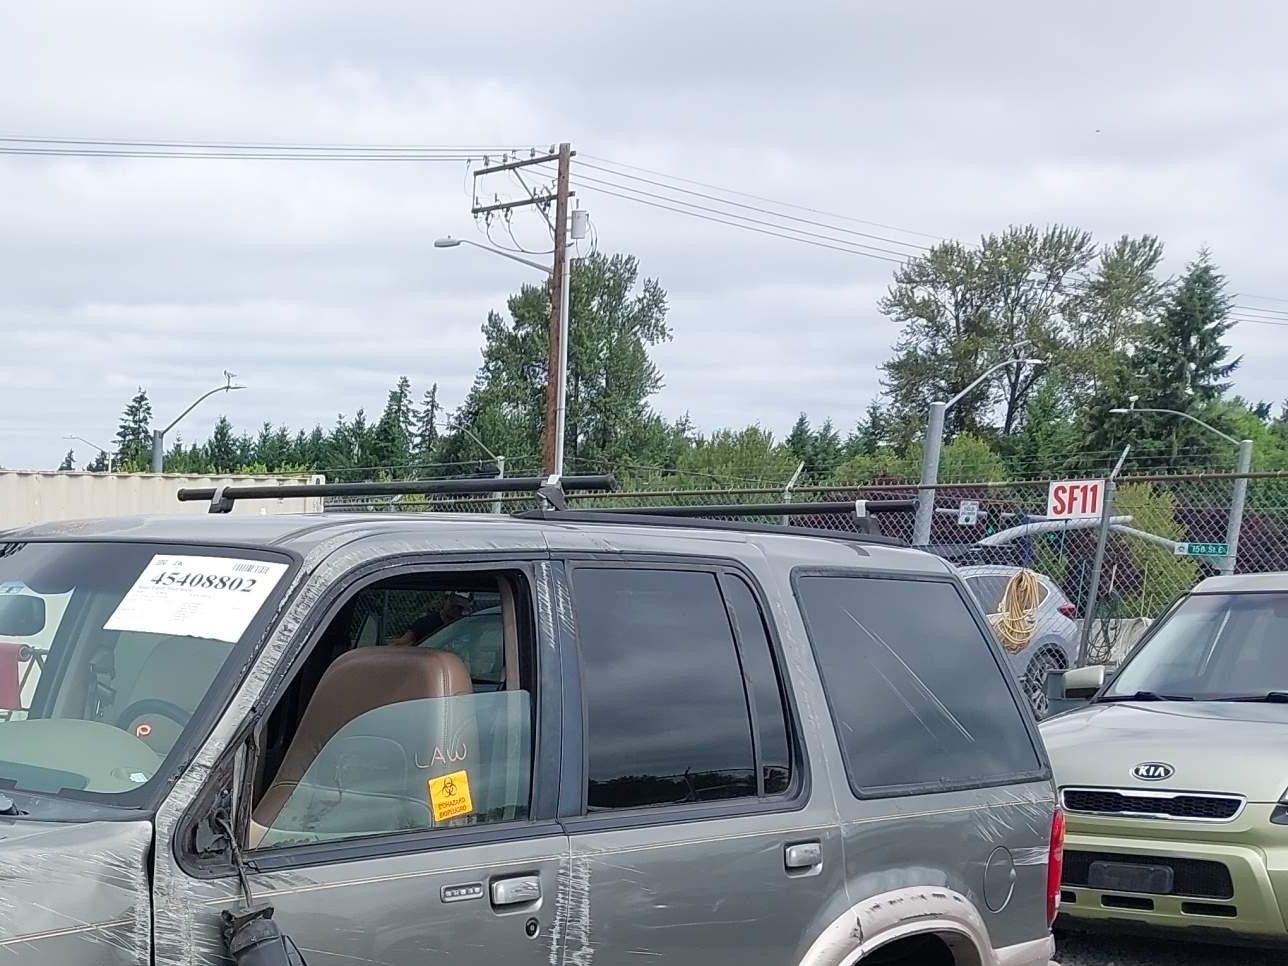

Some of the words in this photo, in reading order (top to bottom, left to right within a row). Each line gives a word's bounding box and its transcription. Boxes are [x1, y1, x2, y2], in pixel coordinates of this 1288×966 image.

[1052, 484, 1099, 515] SF11
[151, 571, 257, 593] 45408802
[1137, 765, 1166, 778] KIA
